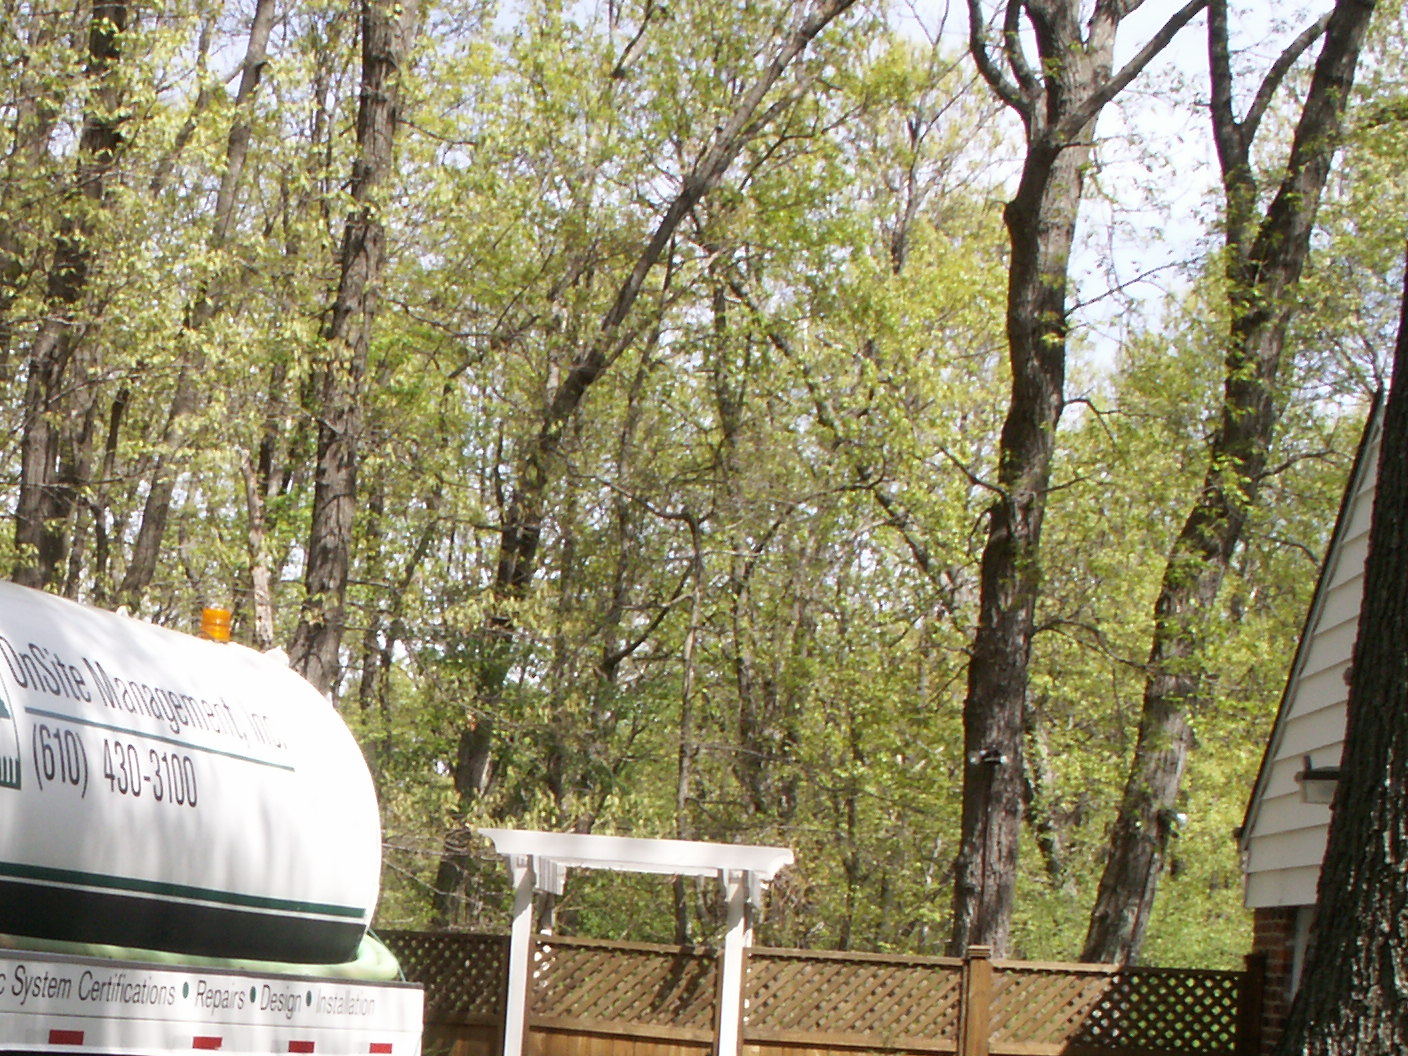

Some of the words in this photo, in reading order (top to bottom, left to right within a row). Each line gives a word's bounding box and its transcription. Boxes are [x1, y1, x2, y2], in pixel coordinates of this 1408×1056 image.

[32, 723, 88, 799] (610)
[103, 738, 198, 807] 430-3100
[11, 964, 72, 1006] System
[78, 970, 176, 1006] Certifications
[194, 980, 246, 1016] Repairs
[260, 984, 302, 1020] Design
[315, 988, 376, 1016] Installation
